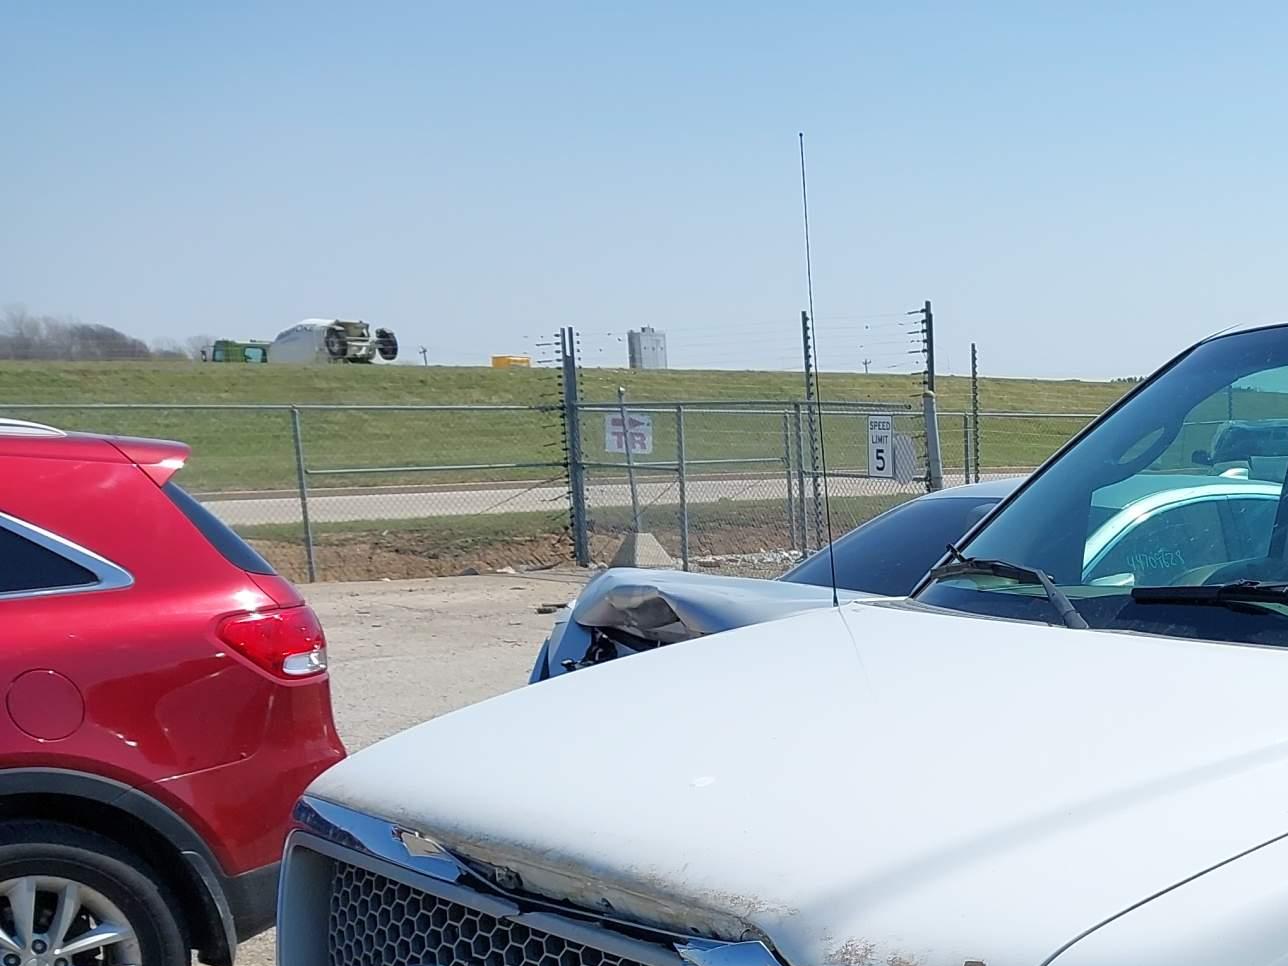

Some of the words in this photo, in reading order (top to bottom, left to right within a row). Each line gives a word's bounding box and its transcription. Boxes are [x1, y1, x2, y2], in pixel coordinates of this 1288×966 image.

[869, 421, 891, 431] SPEED
[871, 434, 888, 445] LIMIT
[876, 448, 886, 471] 5
